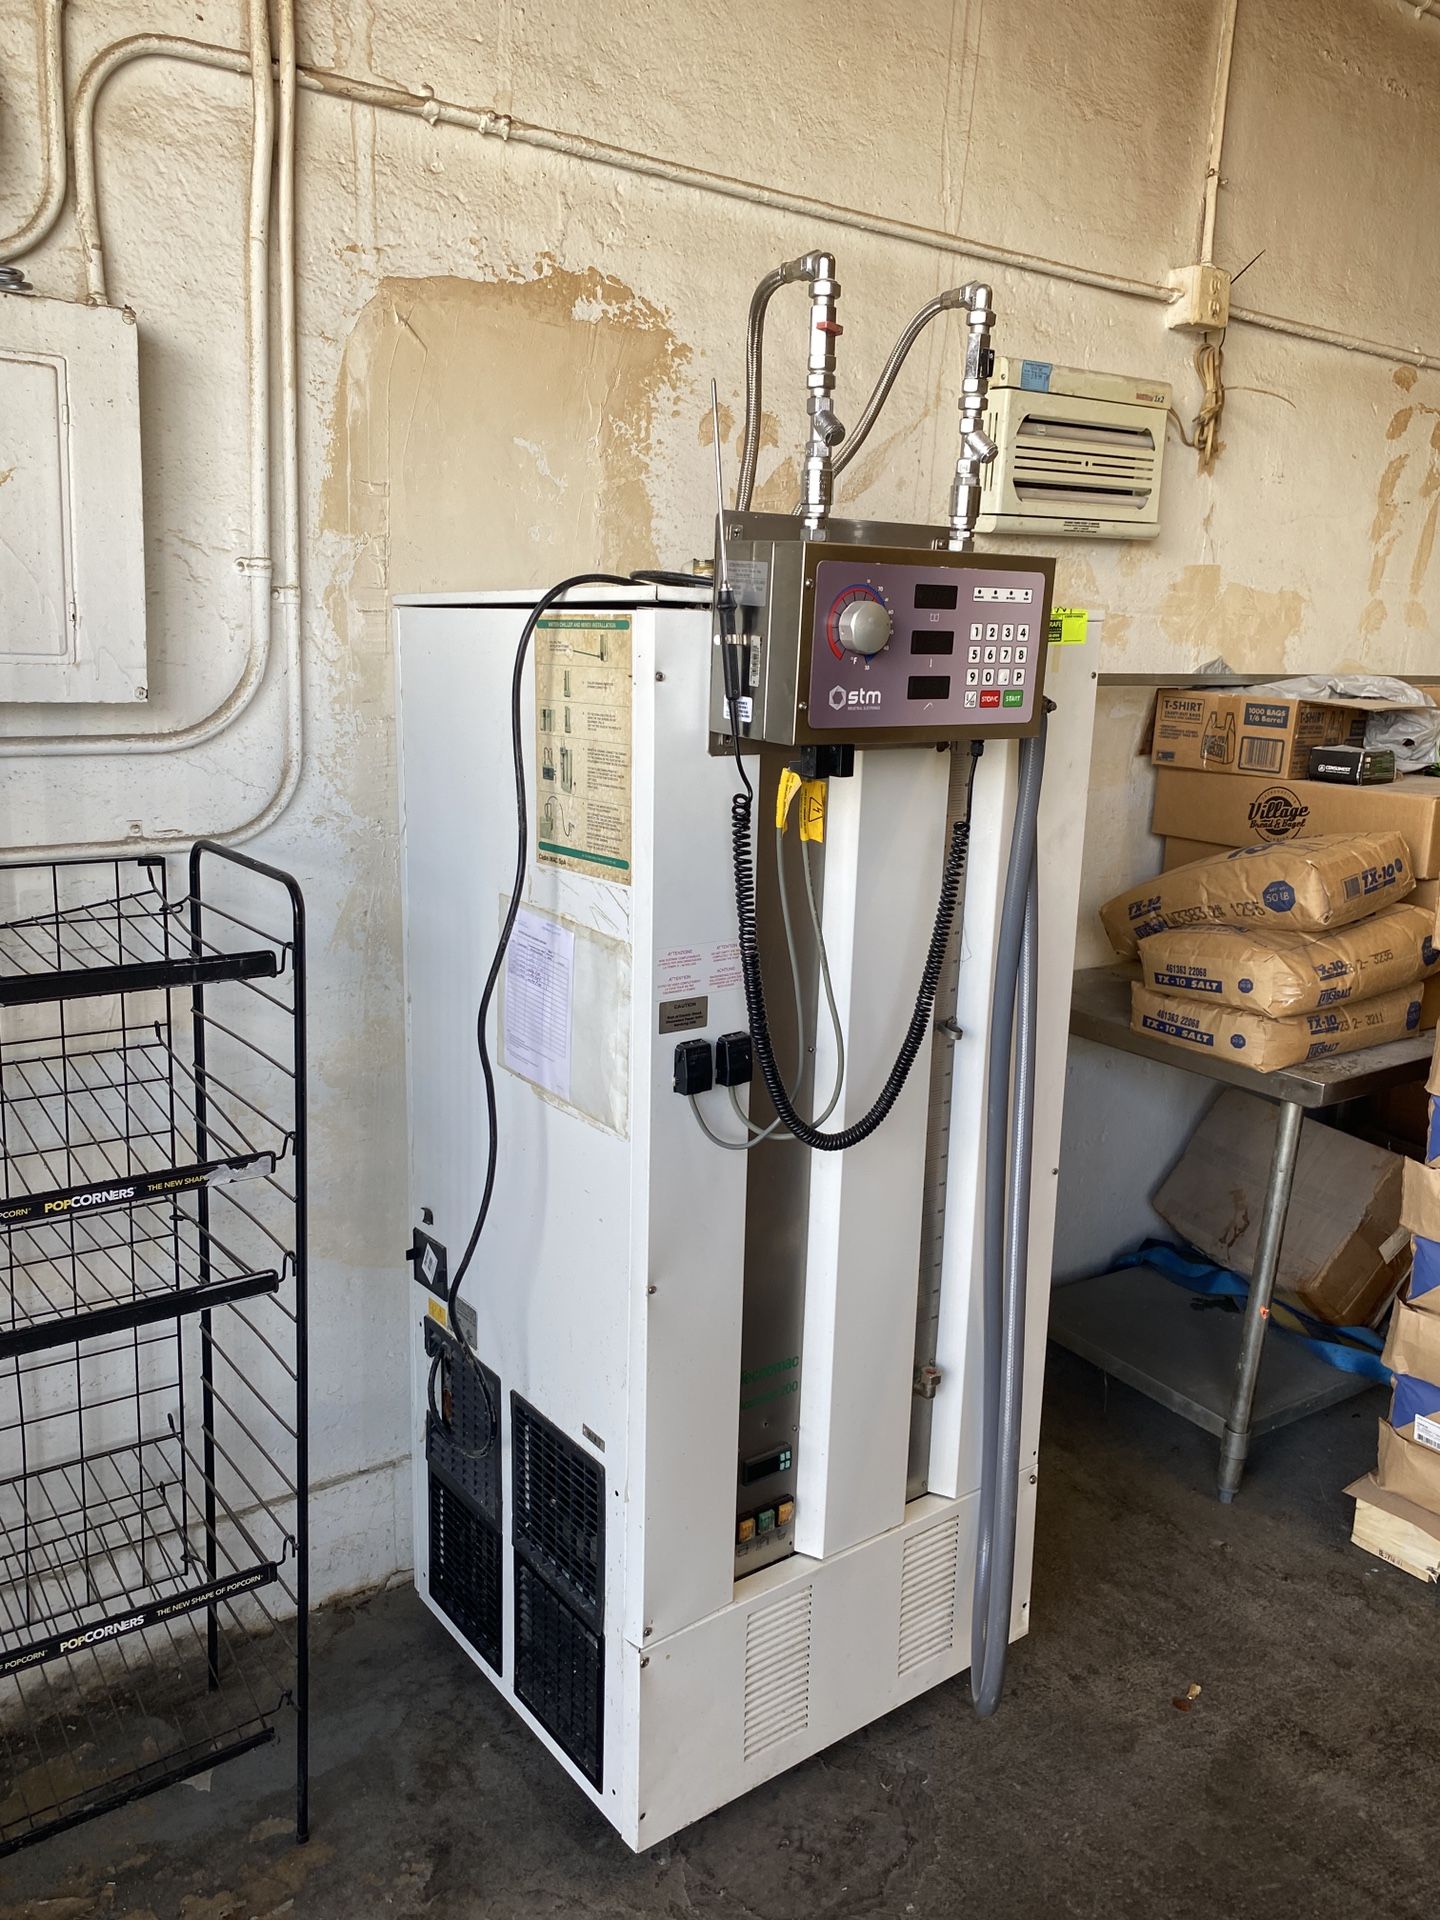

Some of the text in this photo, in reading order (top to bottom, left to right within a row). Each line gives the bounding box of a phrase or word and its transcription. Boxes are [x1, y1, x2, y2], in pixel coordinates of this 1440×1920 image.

[990, 627, 996, 638] 2
[1005, 628, 1011, 638] 3
[1020, 628, 1026, 638] 4
[972, 650, 1024, 660] 5 6 7 8
[970, 672, 976, 682] 9
[986, 672, 992, 682] 0
[1016, 672, 1022, 682] P
[848, 688, 882, 704] stm
[1164, 700, 1202, 712] T-SHIRT
[1248, 707, 1286, 716] 1000 BAGS
[1248, 800, 1310, 822] Village
[1250, 818, 1306, 830] Bread & Bagel
[1362, 863, 1395, 888] TX-10
[1266, 892, 1290, 903] 50 LB
[1158, 974, 1219, 990] TX-10 SALT
[1307, 1015, 1337, 1030] TX-10
[1146, 1018, 1210, 1043] TX-10 SALT
[44, 1187, 134, 1213] POPCORNERS
[147, 1182, 162, 1192] THE
[164, 1178, 184, 1189] NEW
[4, 1651, 45, 1670] POPCORN
[60, 1615, 145, 1652] POPCORNERS
[156, 1607, 172, 1617] THE
[172, 1600, 190, 1612] NEW
[191, 1592, 215, 1606] SHAPE
[216, 1588, 226, 1597] OF
[226, 1576, 261, 1592] POPCORN
